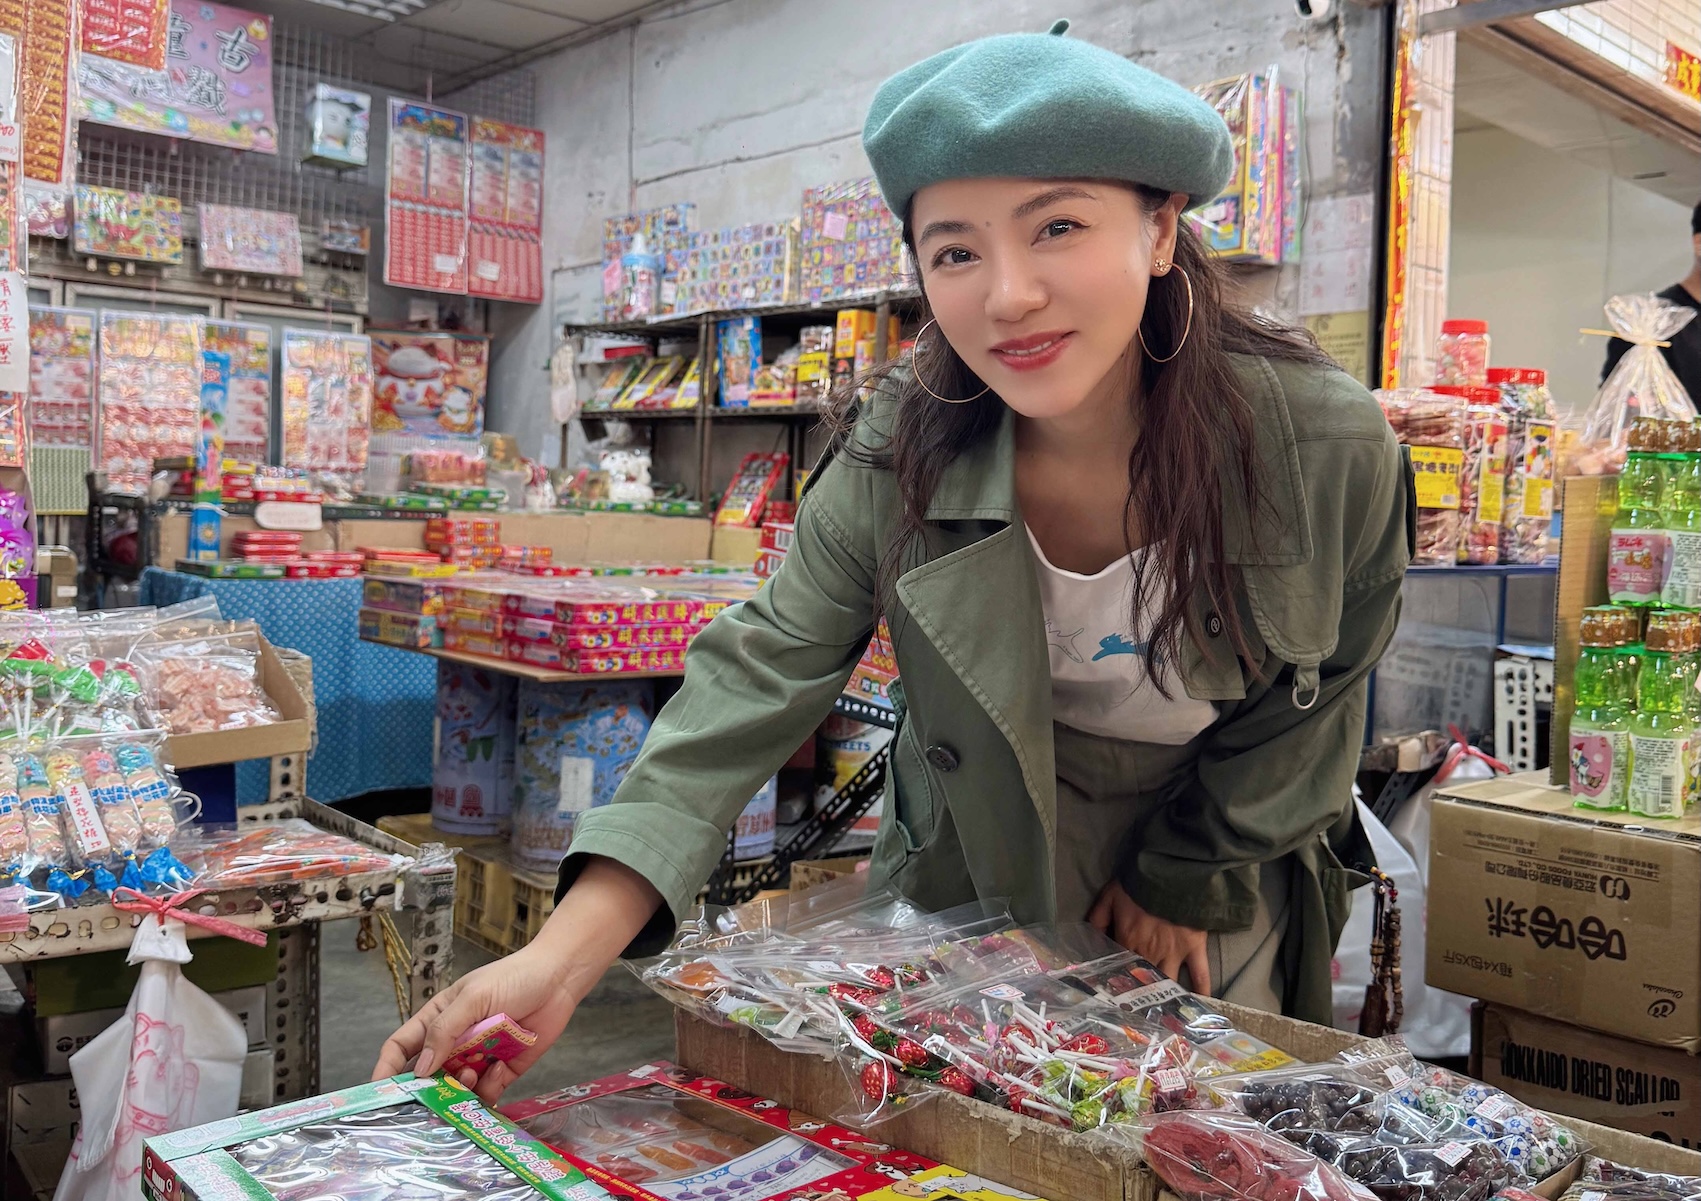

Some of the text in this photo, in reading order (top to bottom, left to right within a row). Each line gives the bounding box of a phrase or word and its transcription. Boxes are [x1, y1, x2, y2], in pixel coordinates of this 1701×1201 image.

[1484, 860, 1597, 894] 宏亞食品股份有限公司
[1548, 865, 1572, 876] FOODS
[1484, 896, 1627, 962] 哈哈球
[1500, 1041, 1568, 1092] HOKKAIDO
[1571, 1056, 1612, 1102] DRIED
